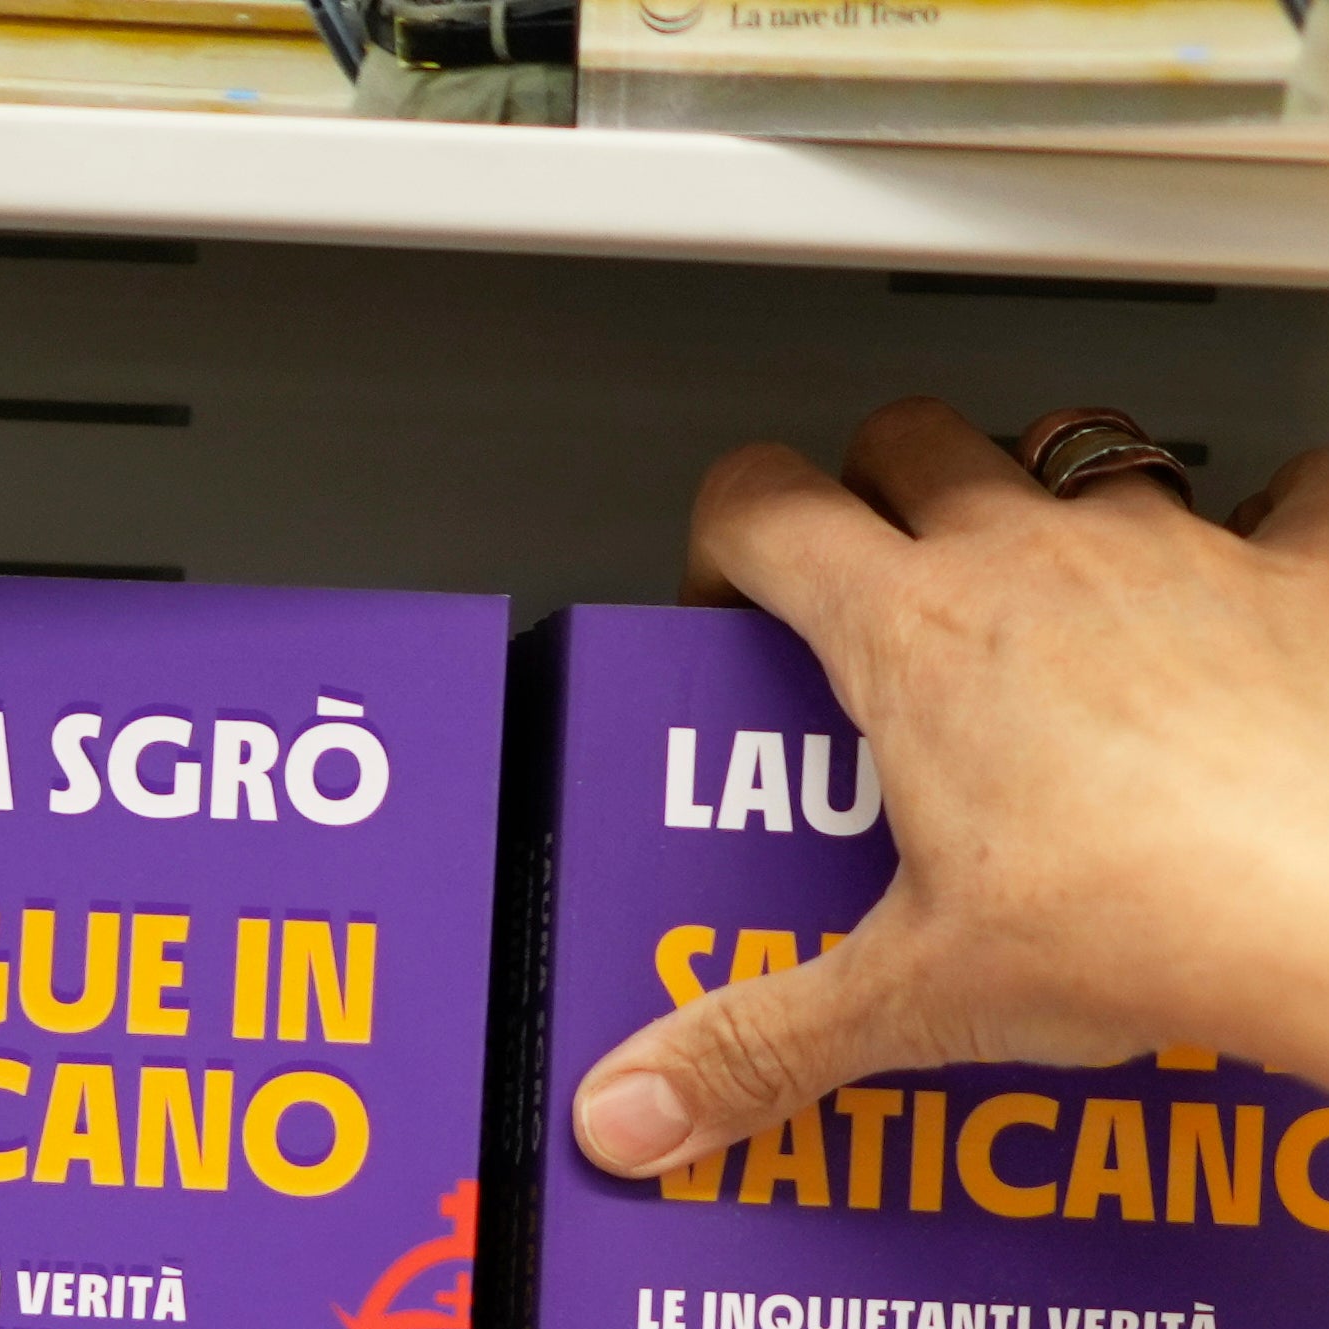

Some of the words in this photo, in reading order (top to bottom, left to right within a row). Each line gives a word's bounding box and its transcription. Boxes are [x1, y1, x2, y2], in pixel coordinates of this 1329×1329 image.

[48, 694, 391, 828] SGRÒ
[663, 726, 883, 836] LAU
[231, 917, 378, 1047] IN
[16, 1265, 188, 1322] VERITÀ
